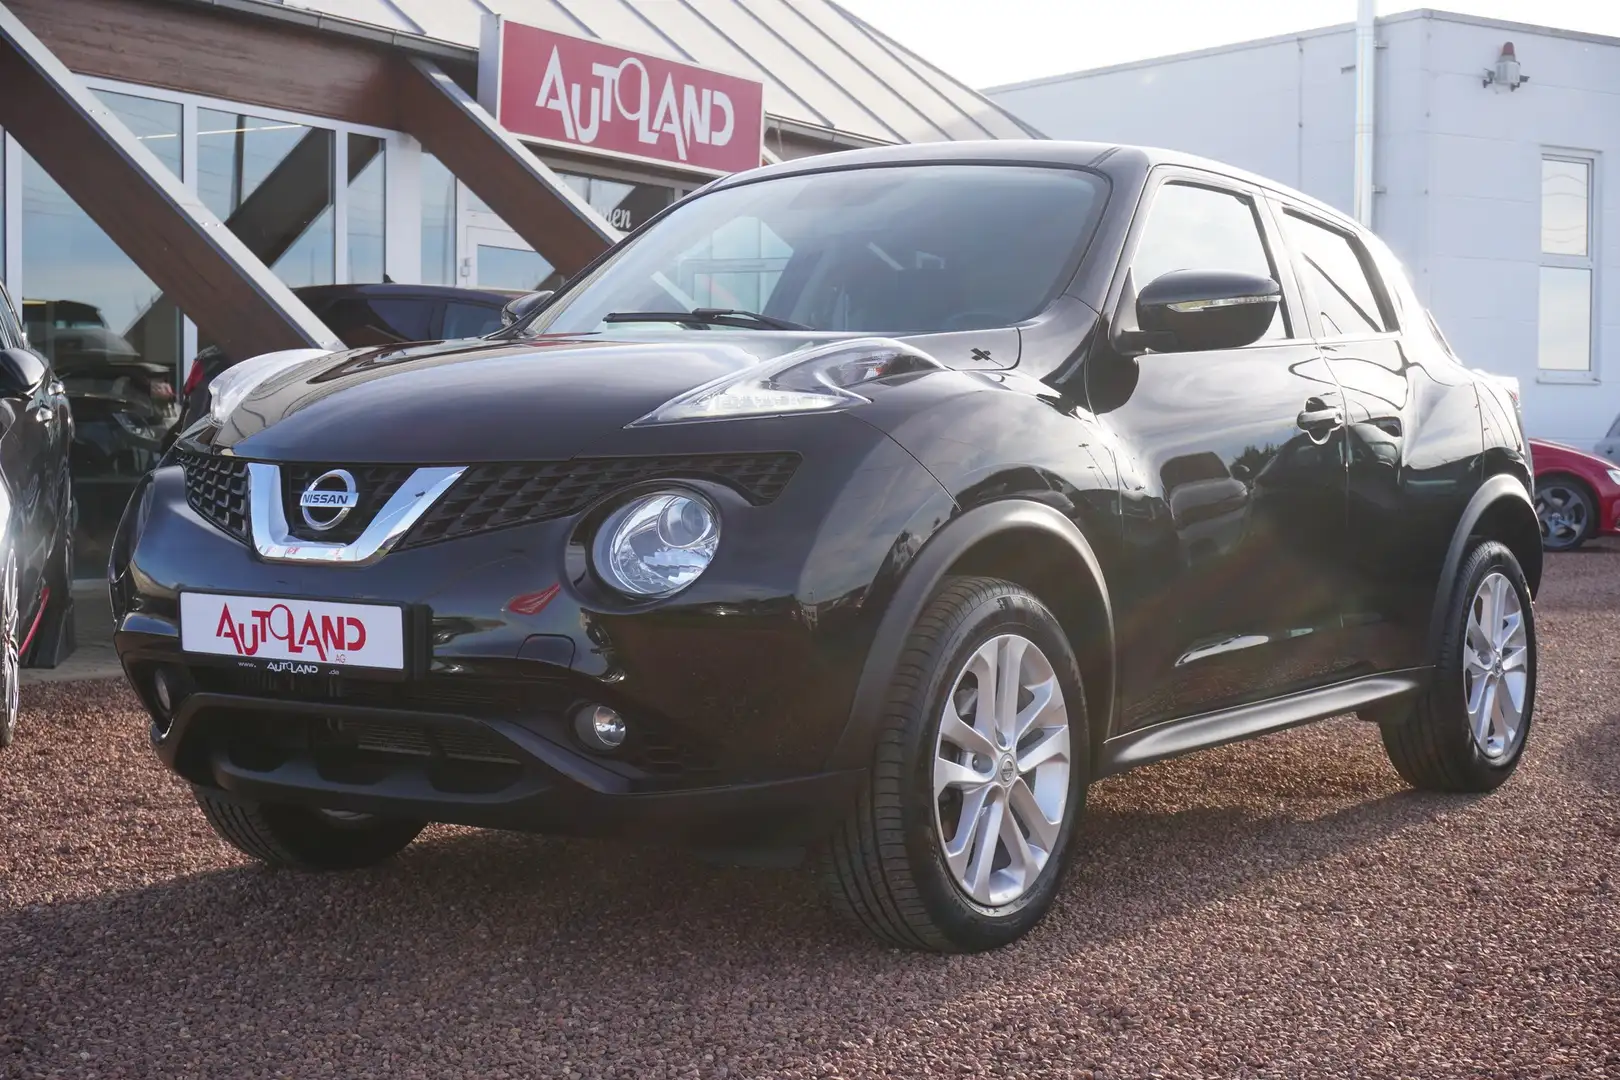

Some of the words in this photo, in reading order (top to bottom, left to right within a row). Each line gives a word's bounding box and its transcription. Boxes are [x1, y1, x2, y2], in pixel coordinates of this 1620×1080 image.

[535, 44, 735, 161] AUTOLAND
[302, 493, 349, 505] NISSAN
[216, 602, 366, 661] AUTOLAND
[335, 653, 346, 663] AG
[267, 661, 318, 675] AUTOLAND
